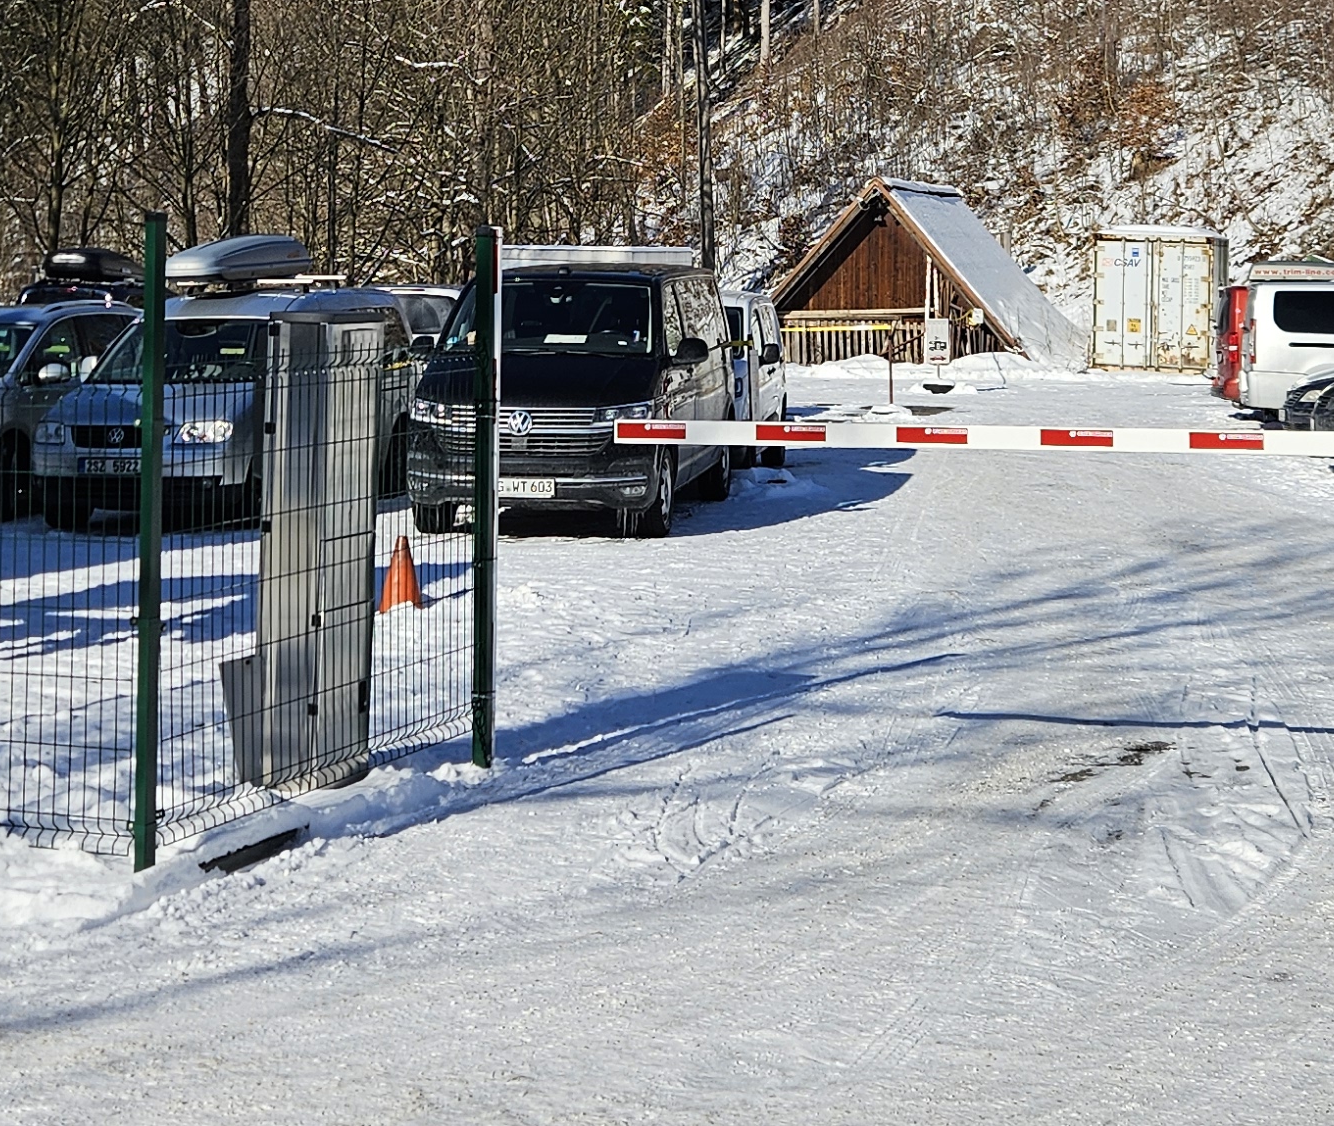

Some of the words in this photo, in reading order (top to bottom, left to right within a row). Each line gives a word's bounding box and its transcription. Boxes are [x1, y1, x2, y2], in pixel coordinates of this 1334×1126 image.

[1114, 259, 1141, 267] CSAV
[113, 460, 139, 473] 5922
[531, 481, 553, 492] 603
